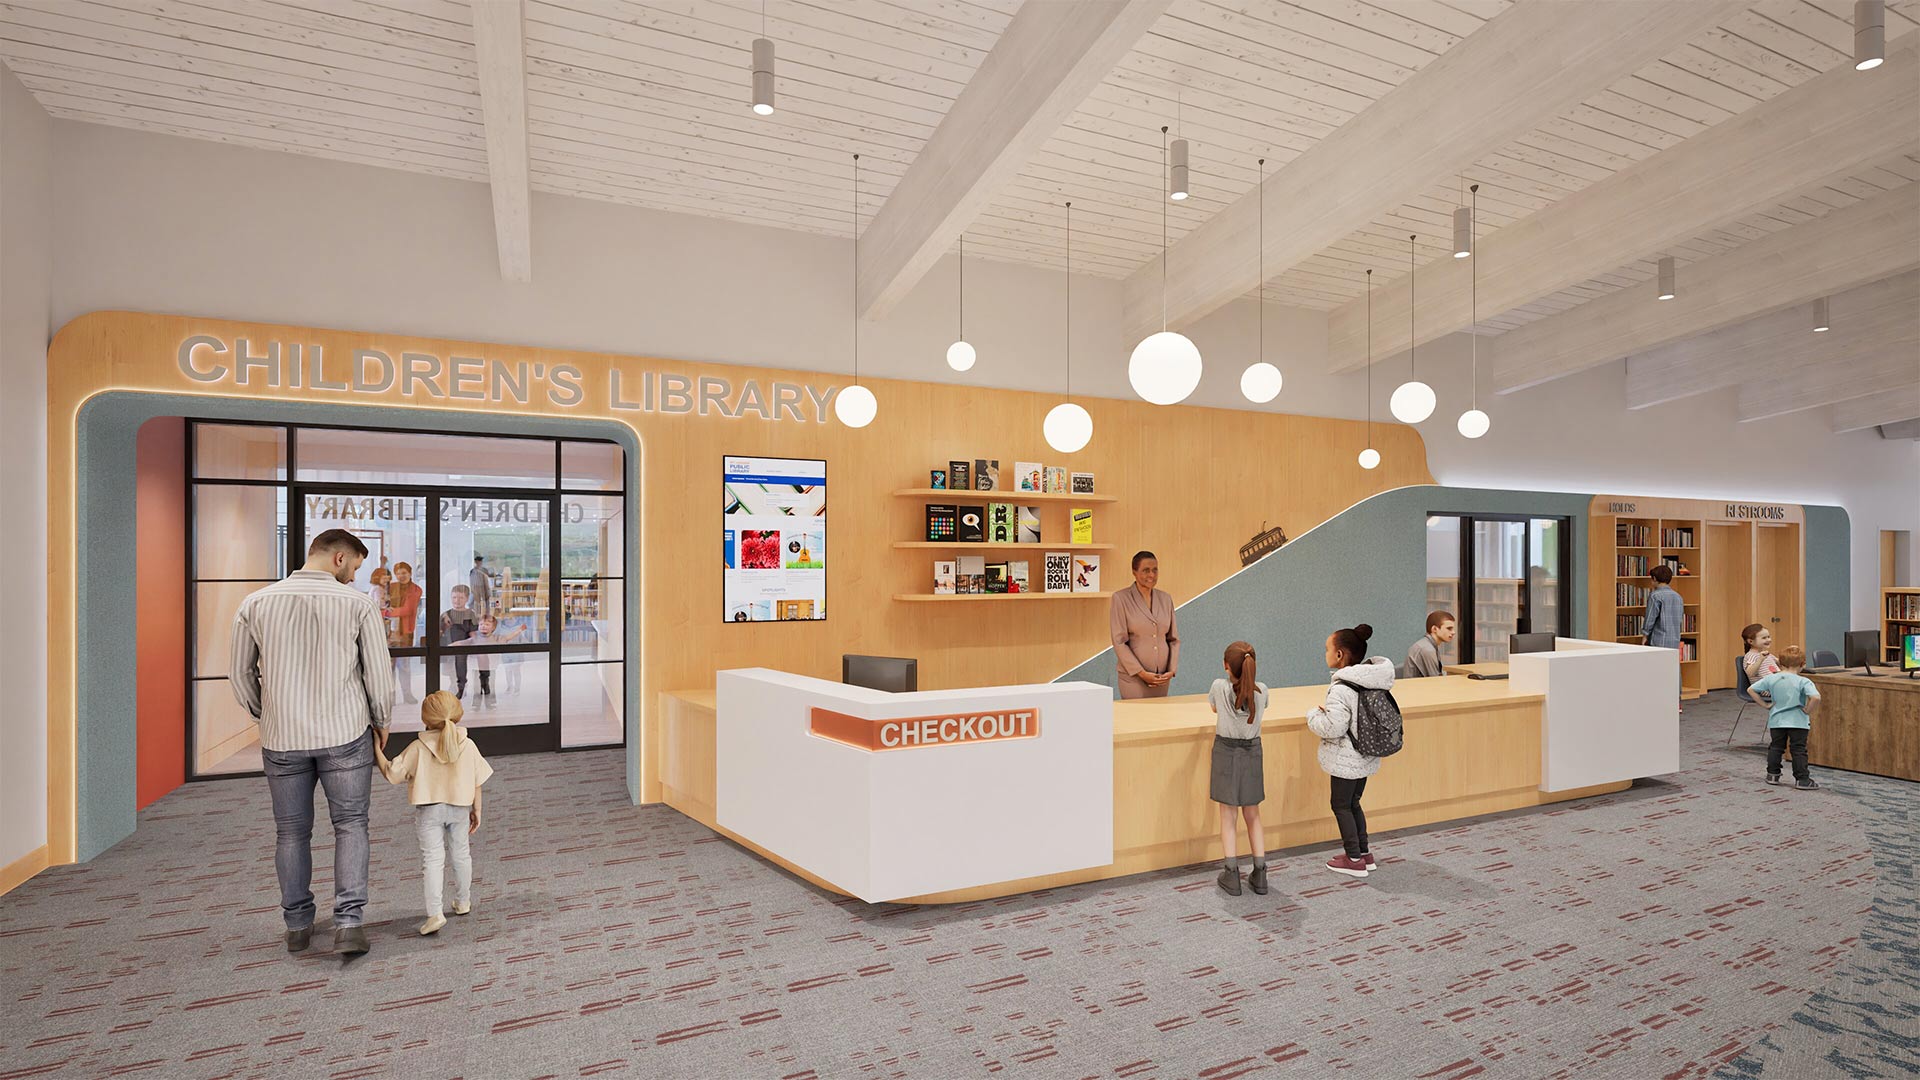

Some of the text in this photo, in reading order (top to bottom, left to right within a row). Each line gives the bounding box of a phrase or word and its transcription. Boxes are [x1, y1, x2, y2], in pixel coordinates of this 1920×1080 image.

[177, 335, 837, 424] CHILDREN'S LIBRARY
[1609, 502, 1636, 513] HOLDS
[1726, 504, 1784, 520] RESTROOMS
[1047, 561, 1069, 569] ONLY
[1047, 574, 1070, 583] ROLL
[880, 712, 1032, 747] CHECKOUT
